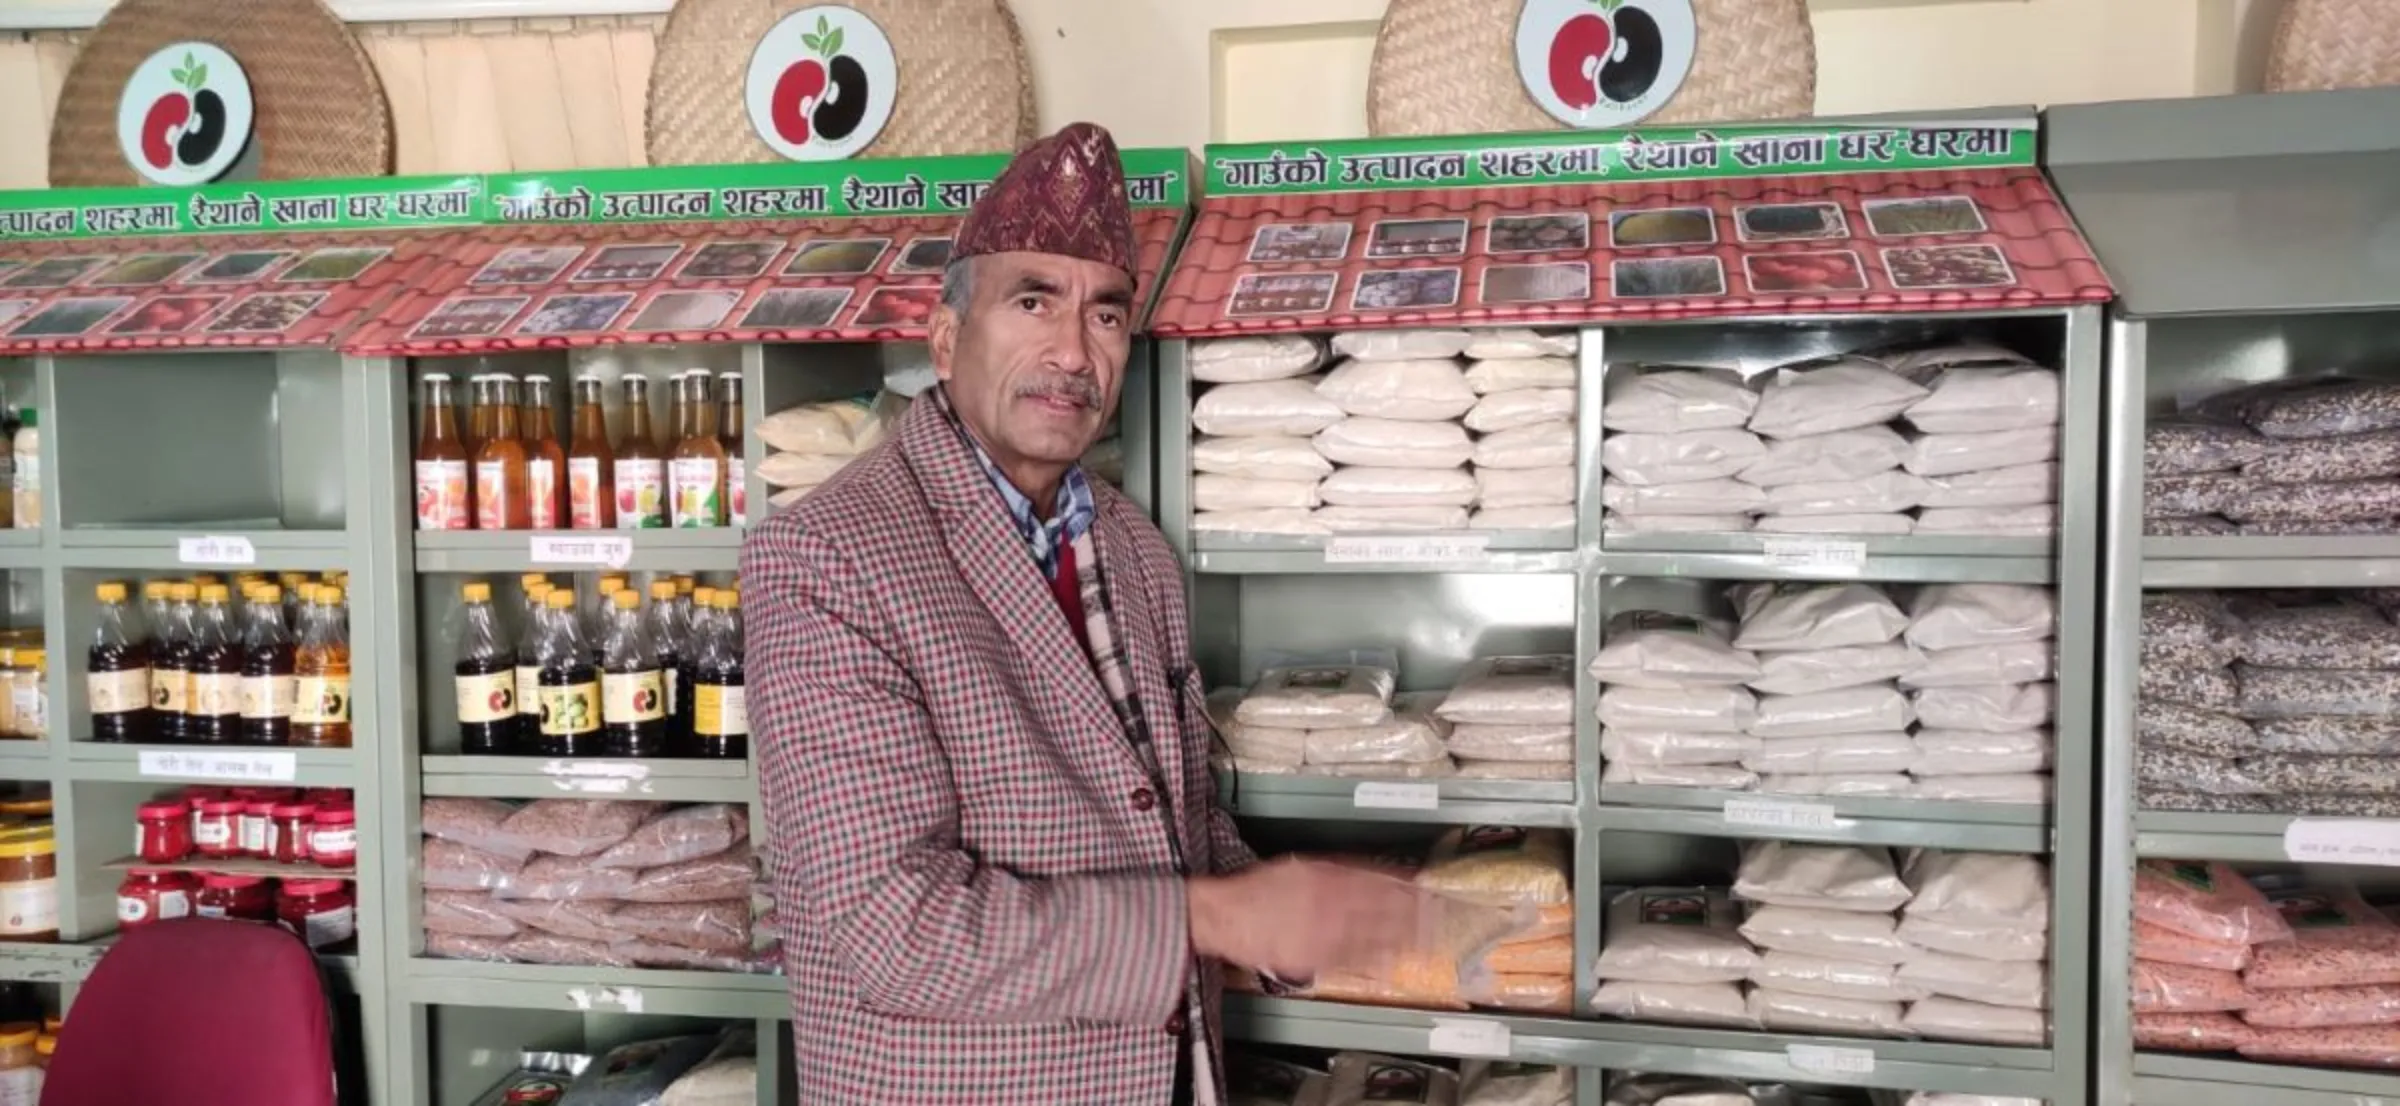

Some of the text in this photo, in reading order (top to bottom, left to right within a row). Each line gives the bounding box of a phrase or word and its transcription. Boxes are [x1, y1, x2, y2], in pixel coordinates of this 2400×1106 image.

[1341, 154, 1467, 182] उत्पादन
[1623, 133, 1718, 170] रैथाने
[1735, 138, 1824, 166] खाना
[192, 193, 260, 225] रैथाने
[272, 197, 335, 223] खाना
[602, 191, 711, 217] उत्पादन
[845, 177, 926, 210] रैथाने
